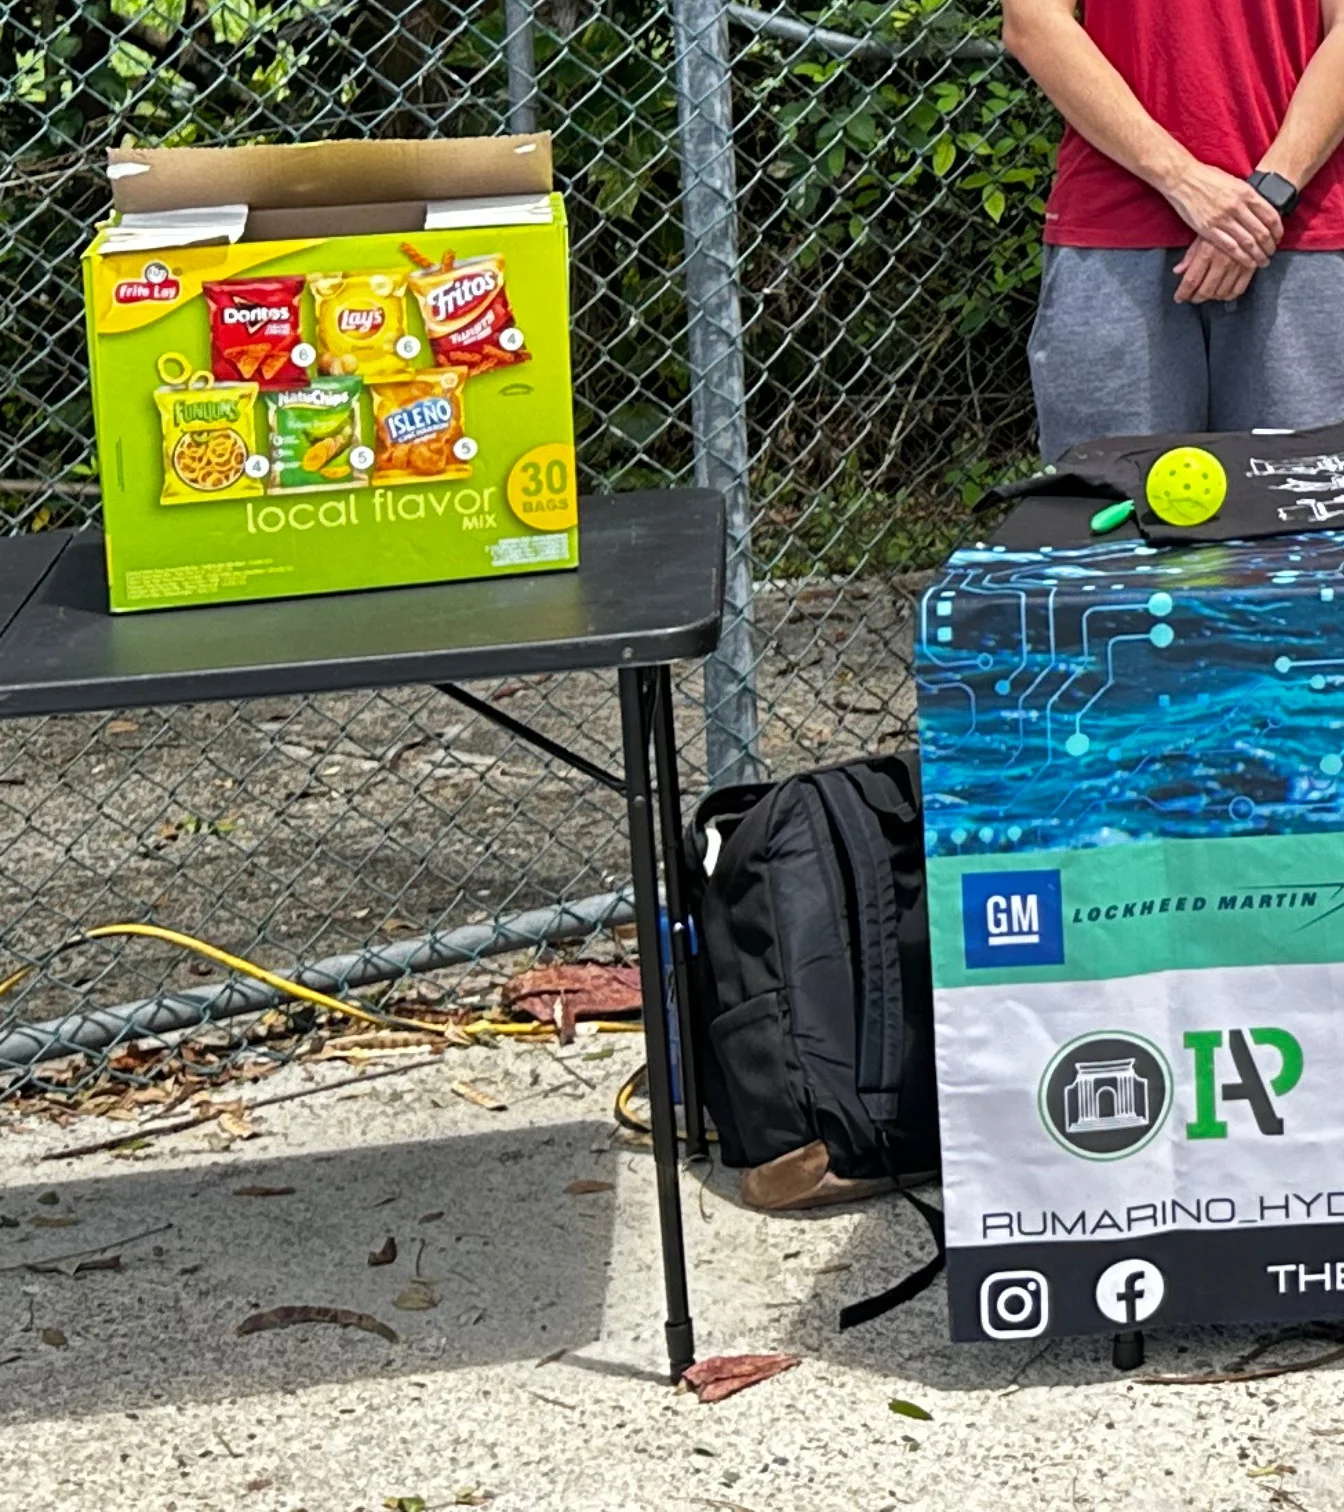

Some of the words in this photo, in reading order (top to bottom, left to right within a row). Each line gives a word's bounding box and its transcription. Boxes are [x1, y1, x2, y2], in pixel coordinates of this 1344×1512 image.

[119, 285, 150, 299] Frito
[153, 283, 177, 298] Lay
[427, 270, 496, 321] Fritos
[223, 306, 290, 324] Doritos
[341, 308, 383, 332] Lay's
[404, 341, 413, 353] 6
[507, 333, 516, 344] 4
[299, 349, 308, 361] 6
[278, 389, 349, 407] NatuChips
[174, 400, 240, 425] FUNYUNS
[358, 451, 367, 464] 5
[461, 442, 471, 455] 5
[252, 460, 261, 472] 4
[521, 459, 568, 497] 30
[246, 493, 360, 535] local
[372, 486, 497, 524] flavor
[522, 498, 569, 513] BAGS
[462, 513, 498, 531] MIX
[986, 894, 1039, 934] GM
[1072, 896, 1207, 924] LOCKHEED
[1217, 891, 1318, 911] MARTIN
